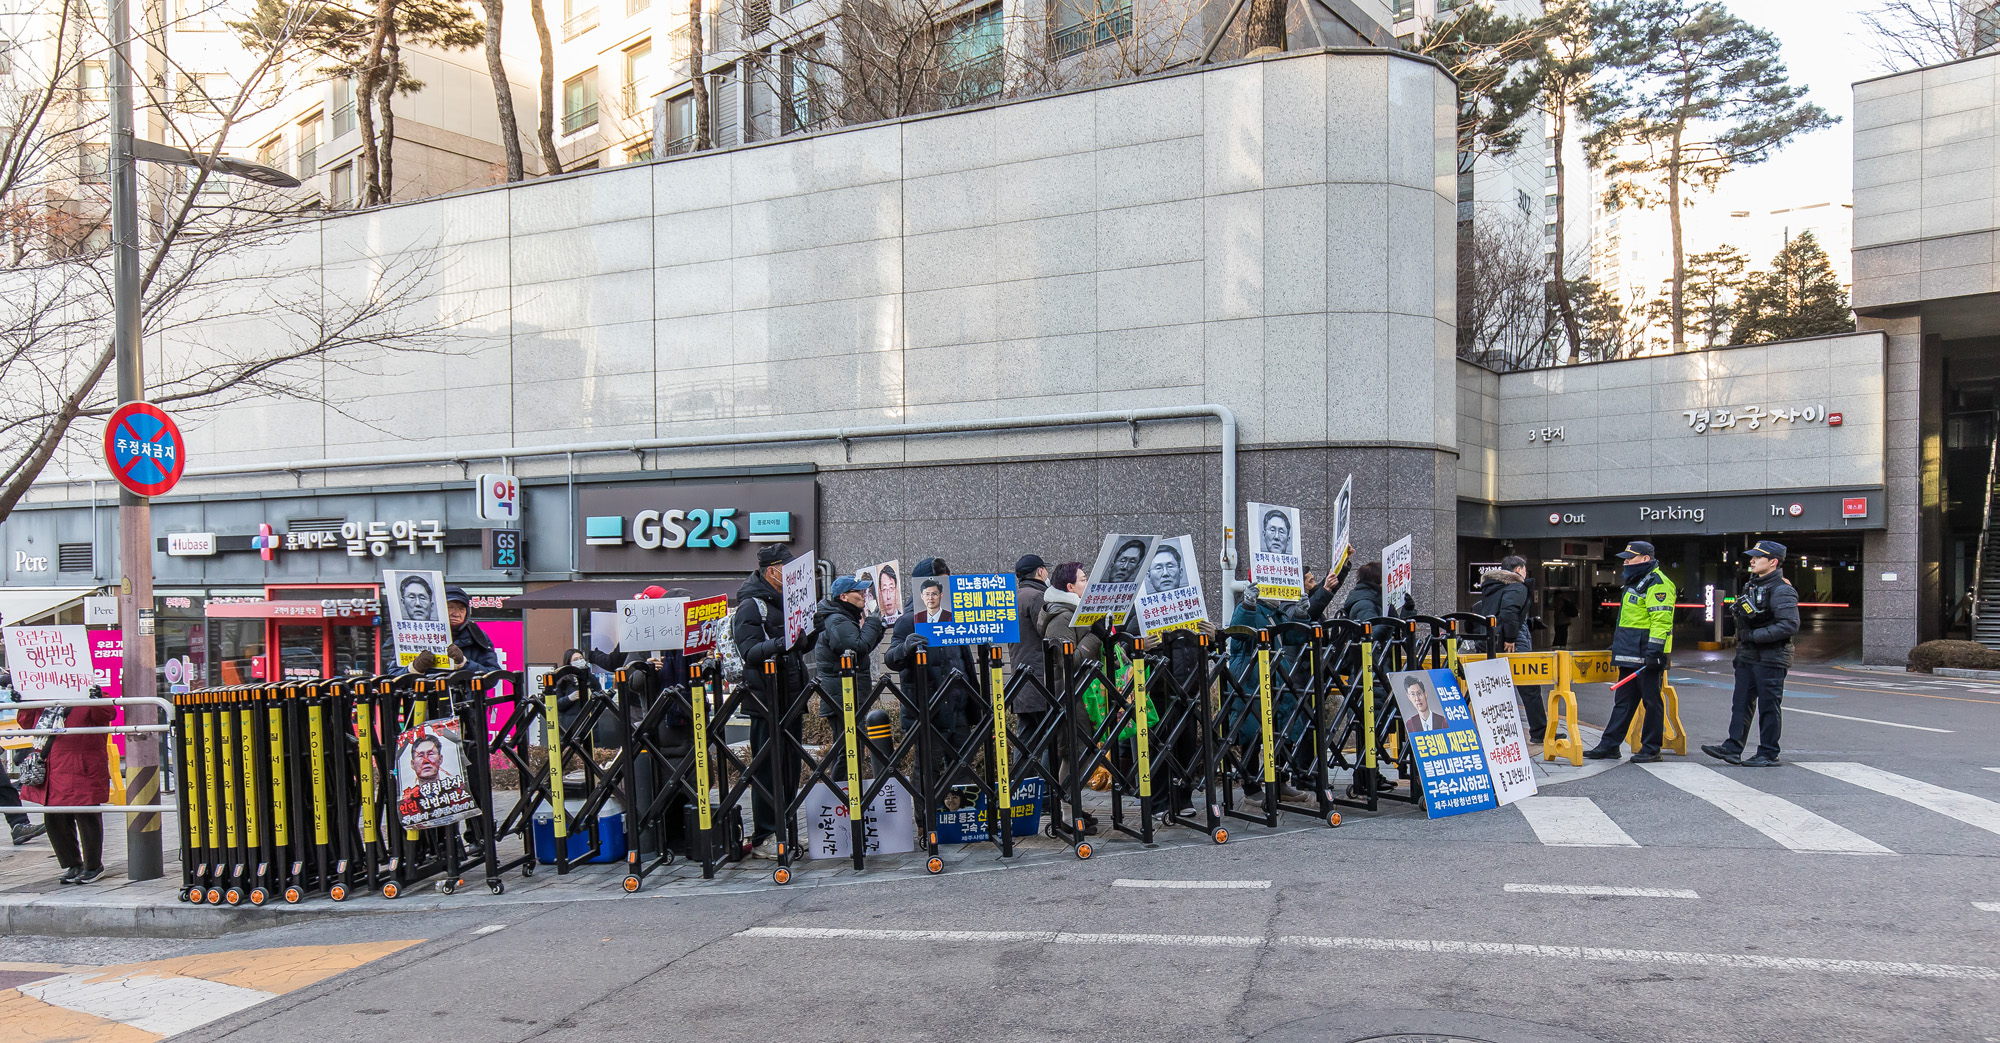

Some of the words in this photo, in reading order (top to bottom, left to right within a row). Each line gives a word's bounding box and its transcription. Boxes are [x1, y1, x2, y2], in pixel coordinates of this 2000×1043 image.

[1683, 405, 1826, 433] 경희궁자이
[1528, 430, 1537, 441] 3
[1540, 425, 1566, 442] 단지
[116, 438, 175, 460] 주정차금지
[493, 480, 516, 516] 약
[1563, 513, 1586, 524] Out
[1639, 505, 1705, 523] Parking
[1771, 504, 1785, 516] In
[285, 531, 338, 550] 휴베이스
[341, 519, 446, 557] 일등약국
[632, 508, 738, 550] GS25
[172, 536, 209, 551] Hubase
[497, 533, 515, 549] GS
[15, 550, 48, 573] Pere
[498, 549, 516, 565] 25
[956, 576, 1007, 591] 민노총하수인
[94, 606, 114, 616] Pere
[320, 598, 381, 617] 일등약국
[952, 591, 984, 609] 문형배
[985, 591, 1015, 607] 재판관
[686, 600, 727, 627] 탄핵무효
[953, 608, 1017, 623] 불법내란주동
[932, 623, 1005, 637] 구속수사하라!
[97, 640, 114, 649] 우리
[1513, 662, 1549, 676] LINE
[1264, 674, 1273, 725] POLICE
[1436, 685, 1462, 702] 민노총
[995, 693, 1006, 748] POLICE
[1444, 704, 1469, 721] 하수인
[694, 712, 705, 768] POLICE
[1414, 732, 1449, 758] 문형배
[1449, 729, 1480, 754] 재판관
[204, 737, 212, 790] POLICE
[243, 735, 251, 788] POLICE
[311, 731, 319, 785] POLICE
[1422, 753, 1484, 779] 불법내란주동
[420, 774, 463, 796] 정치판사
[1000, 758, 1008, 794] LINE
[1427, 773, 1491, 799] 구속수사하라!
[399, 800, 418, 815] 인민
[420, 789, 472, 810] 헌법재판소
[699, 779, 707, 815] LINE
[1434, 792, 1490, 811] 제주사랑청년연합회
[314, 796, 322, 830] LINE
[939, 813, 957, 824] 내란
[961, 823, 978, 834] 구속
